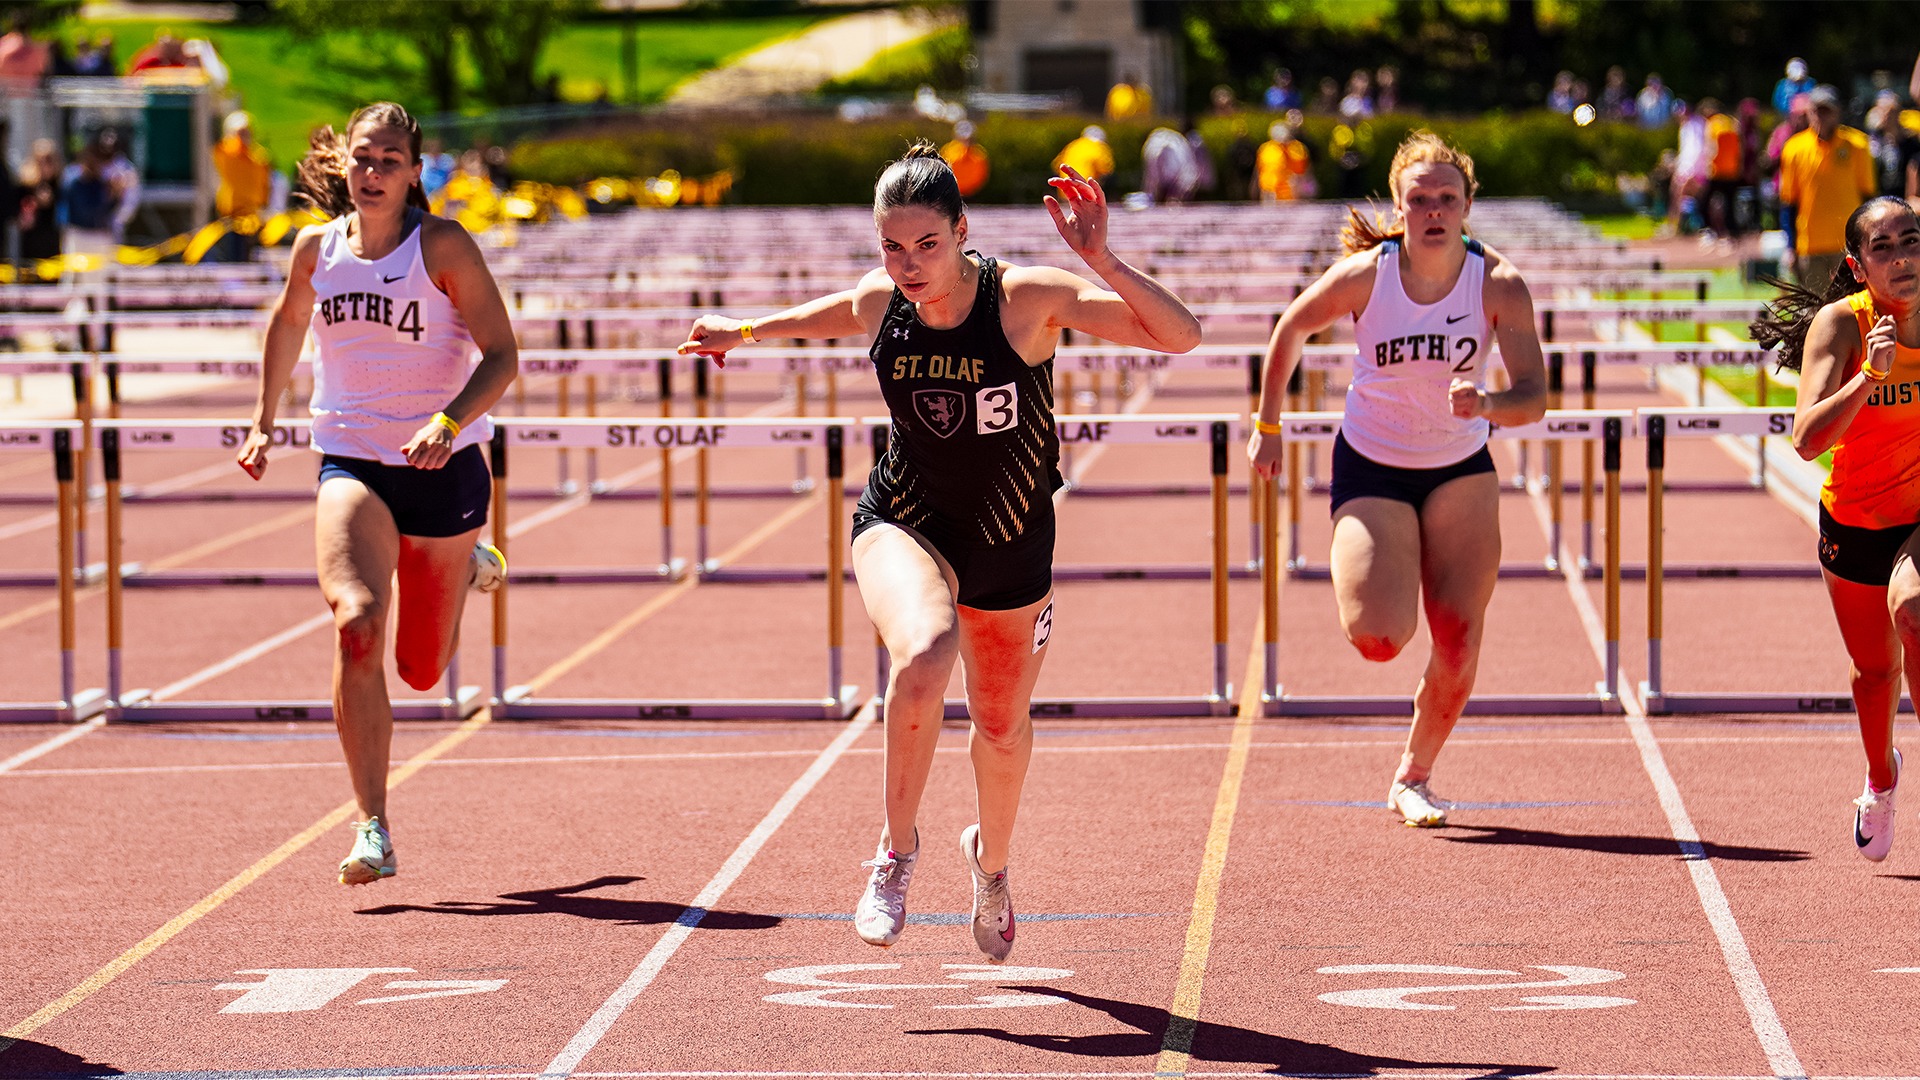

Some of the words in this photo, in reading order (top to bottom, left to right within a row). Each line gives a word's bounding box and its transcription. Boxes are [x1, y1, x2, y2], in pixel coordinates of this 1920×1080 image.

[397, 300, 424, 341] 4
[1375, 334, 1450, 367] BETH
[1452, 336, 1477, 372] 2
[892, 355, 923, 380] ST.
[928, 355, 984, 383] OLAF
[984, 389, 1013, 430] 3
[1678, 419, 1721, 429] UCS
[607, 425, 646, 446] ST.
[654, 425, 726, 446] OLAF
[1291, 424, 1333, 434] UCS
[1548, 422, 1590, 432] UCS
[1037, 603, 1052, 646] 3
